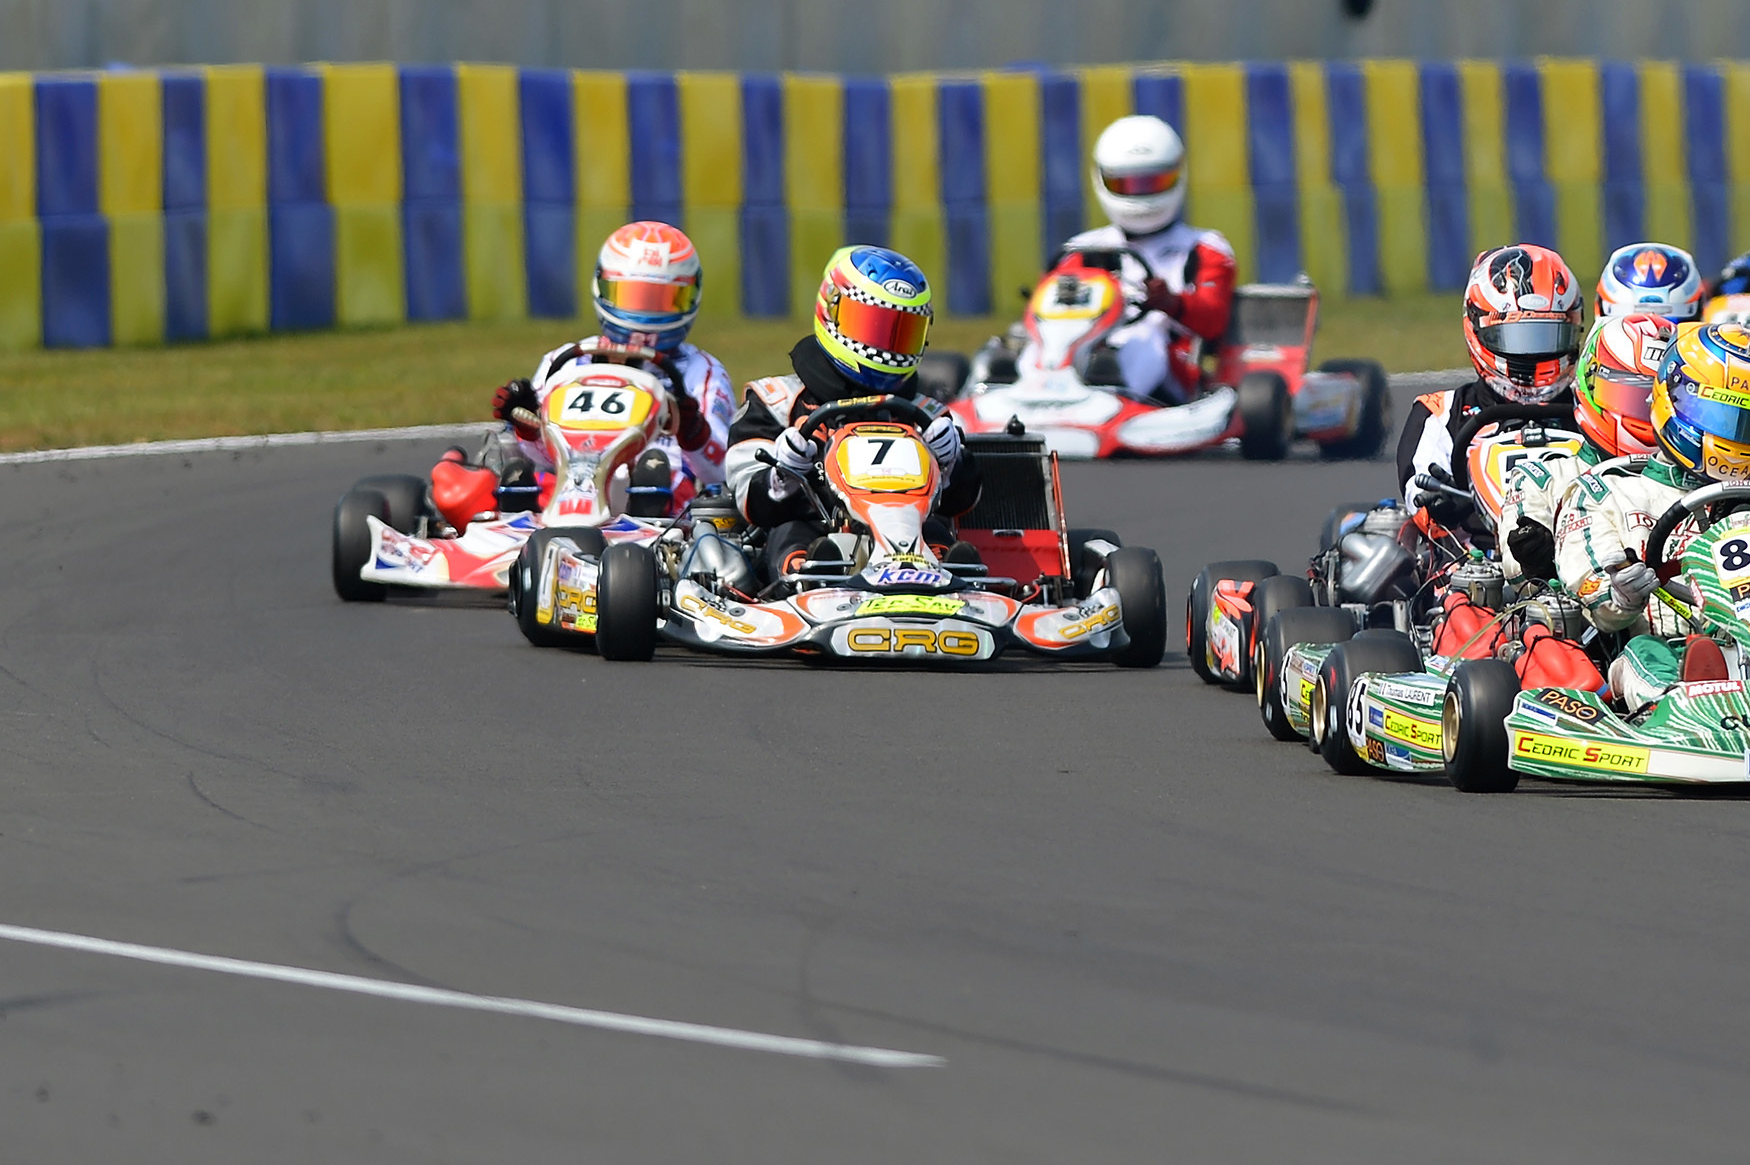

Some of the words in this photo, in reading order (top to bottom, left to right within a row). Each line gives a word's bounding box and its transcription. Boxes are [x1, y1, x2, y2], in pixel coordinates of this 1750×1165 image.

[890, 282, 914, 295] Arai
[568, 391, 627, 415] 46
[867, 439, 896, 466] 7
[680, 595, 757, 634] CRG
[1058, 604, 1119, 639] CRG
[847, 628, 980, 656] CRG
[1690, 683, 1742, 697] MOTUL
[1540, 690, 1599, 722] PASO
